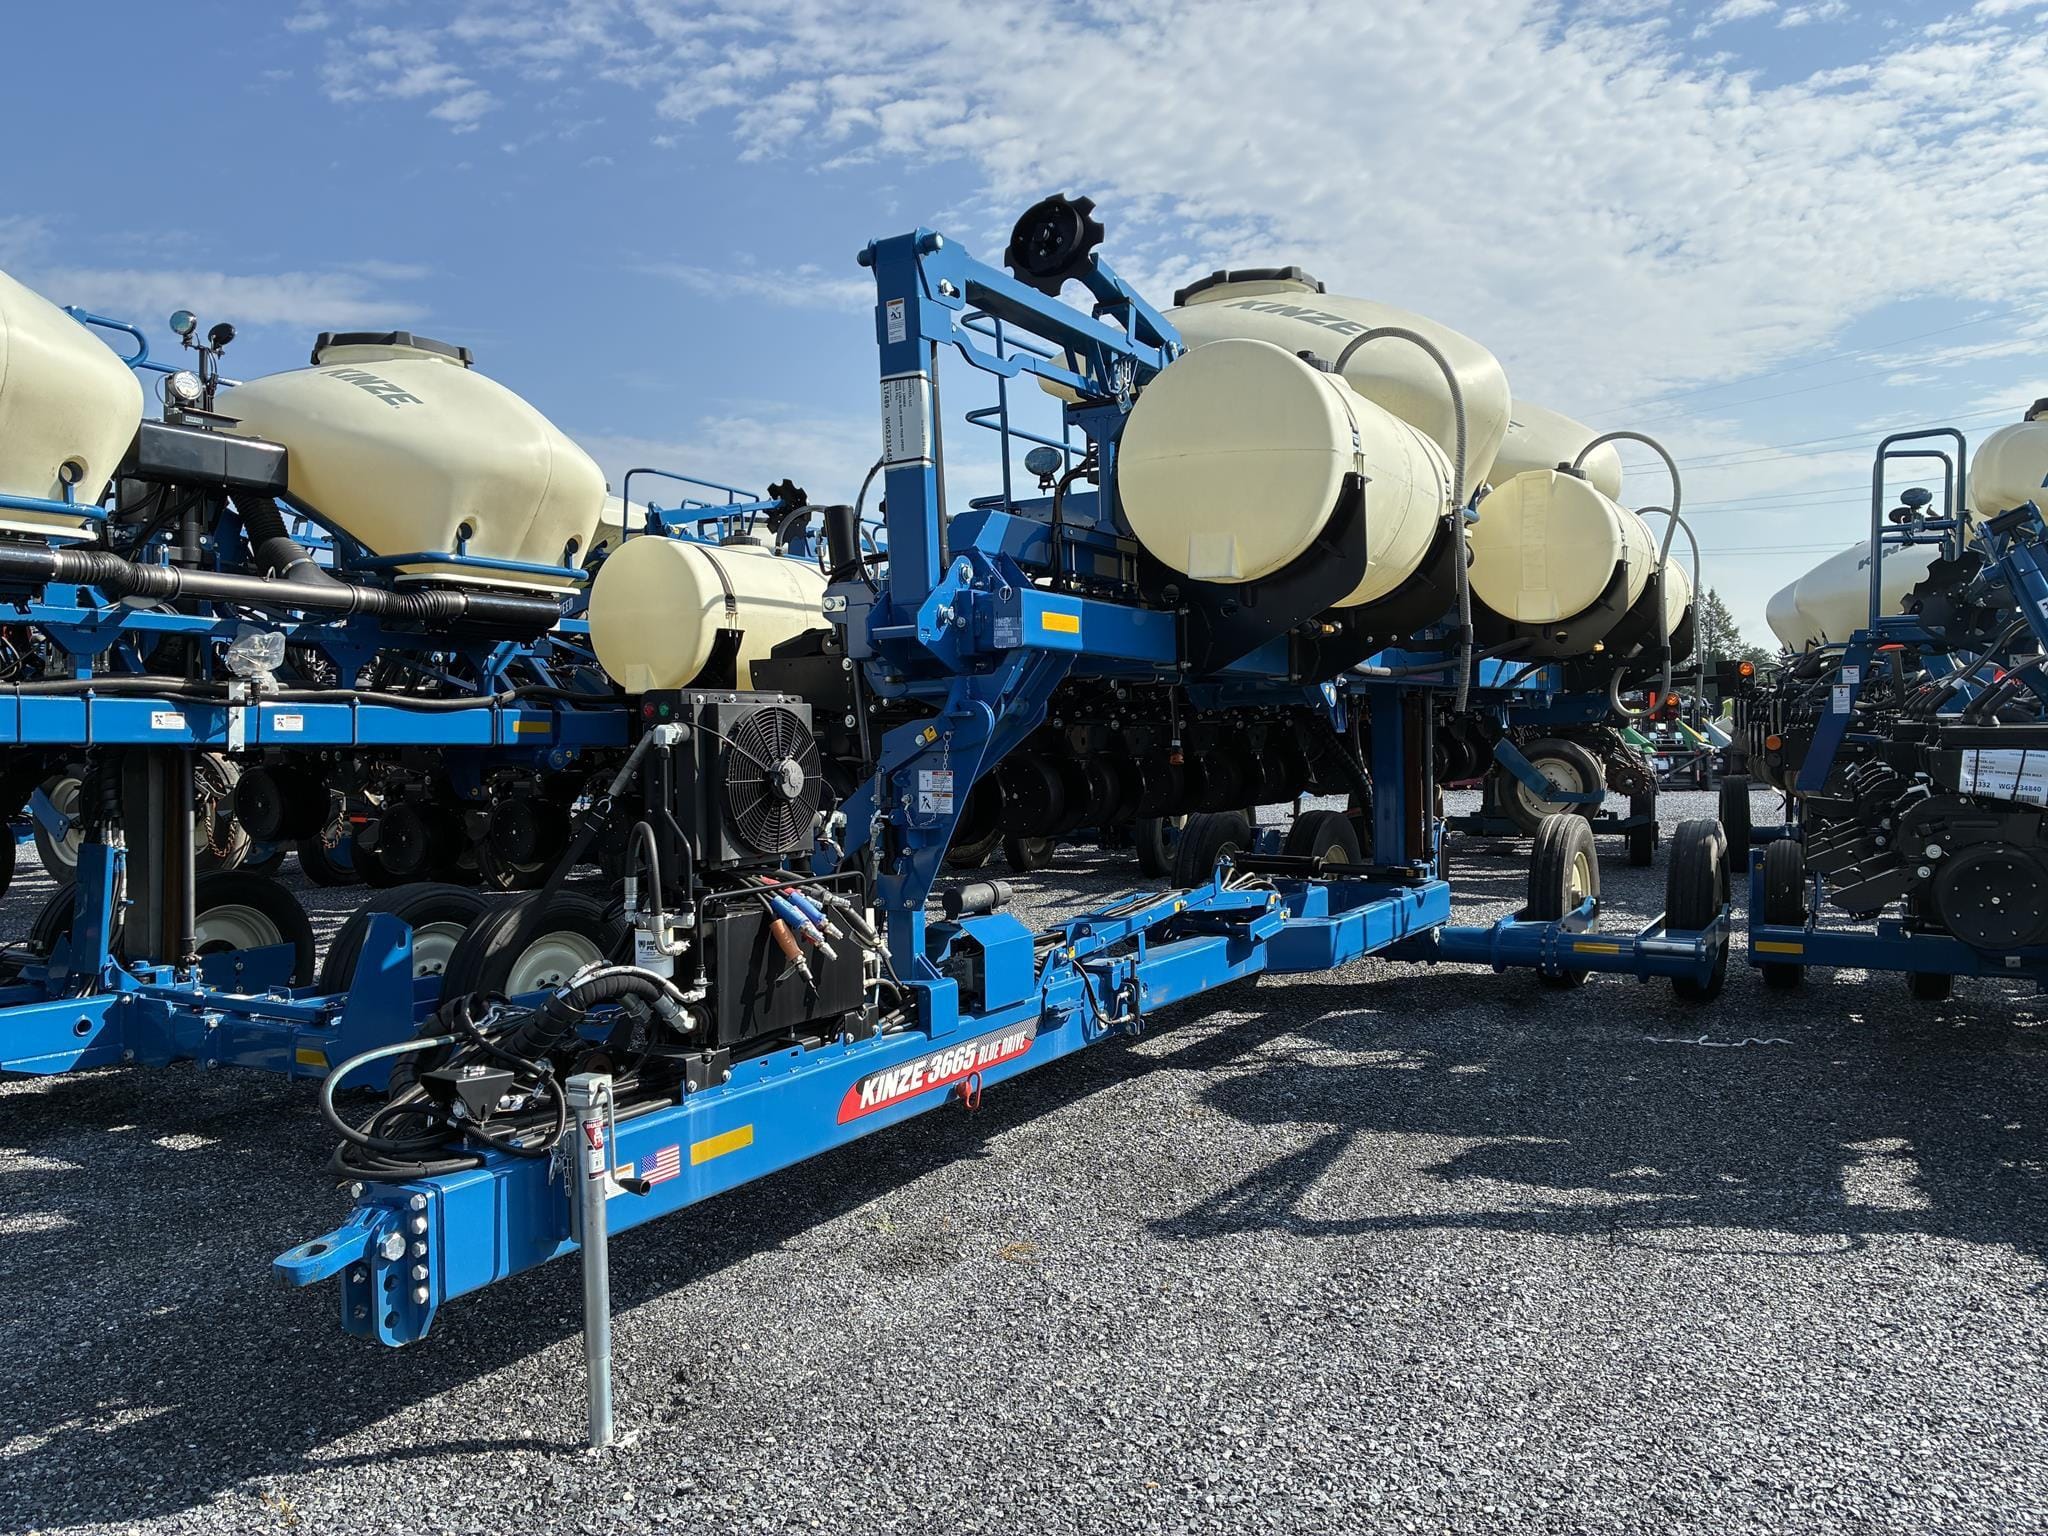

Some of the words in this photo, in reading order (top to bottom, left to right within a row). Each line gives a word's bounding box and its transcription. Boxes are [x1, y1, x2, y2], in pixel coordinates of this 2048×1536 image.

[1223, 300, 1371, 336] KINZE
[319, 367, 424, 406] KINZE
[1965, 780, 1991, 789] 12332
[859, 1059, 928, 1110] KINZE
[927, 1042, 978, 1084] 3665
[978, 1042, 1001, 1065] BLUE
[1001, 1031, 1028, 1057] DRIVE
